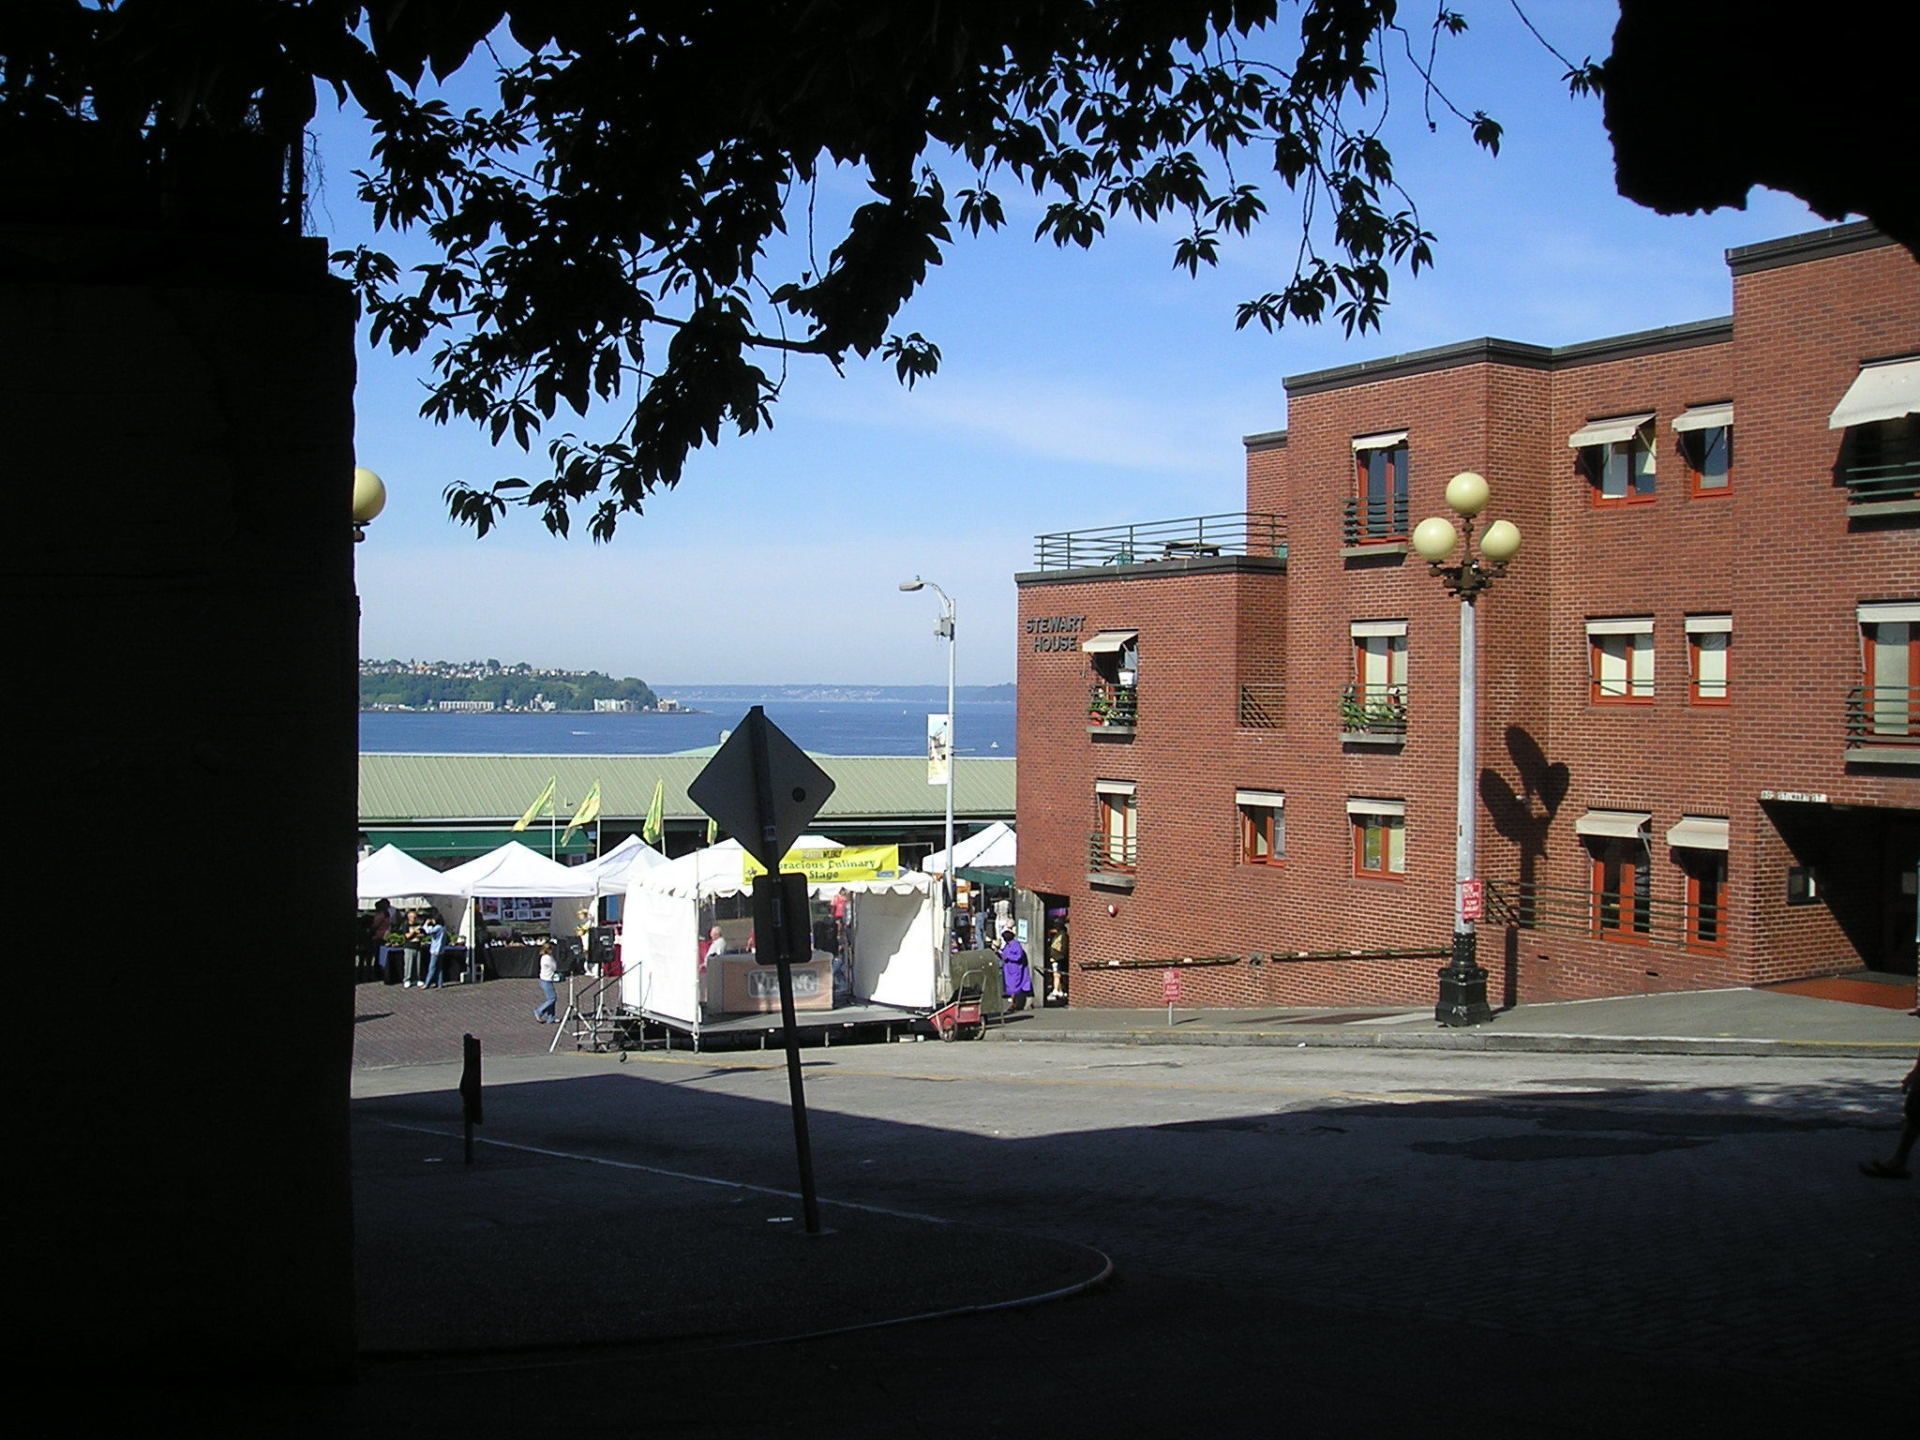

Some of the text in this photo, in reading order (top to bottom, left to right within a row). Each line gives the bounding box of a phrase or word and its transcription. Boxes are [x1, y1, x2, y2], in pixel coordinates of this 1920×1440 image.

[1025, 615, 1086, 633] STEWART
[1034, 635, 1077, 652] HOUSE
[779, 858, 876, 871] oracious Culinary
[808, 870, 839, 880] Stage
